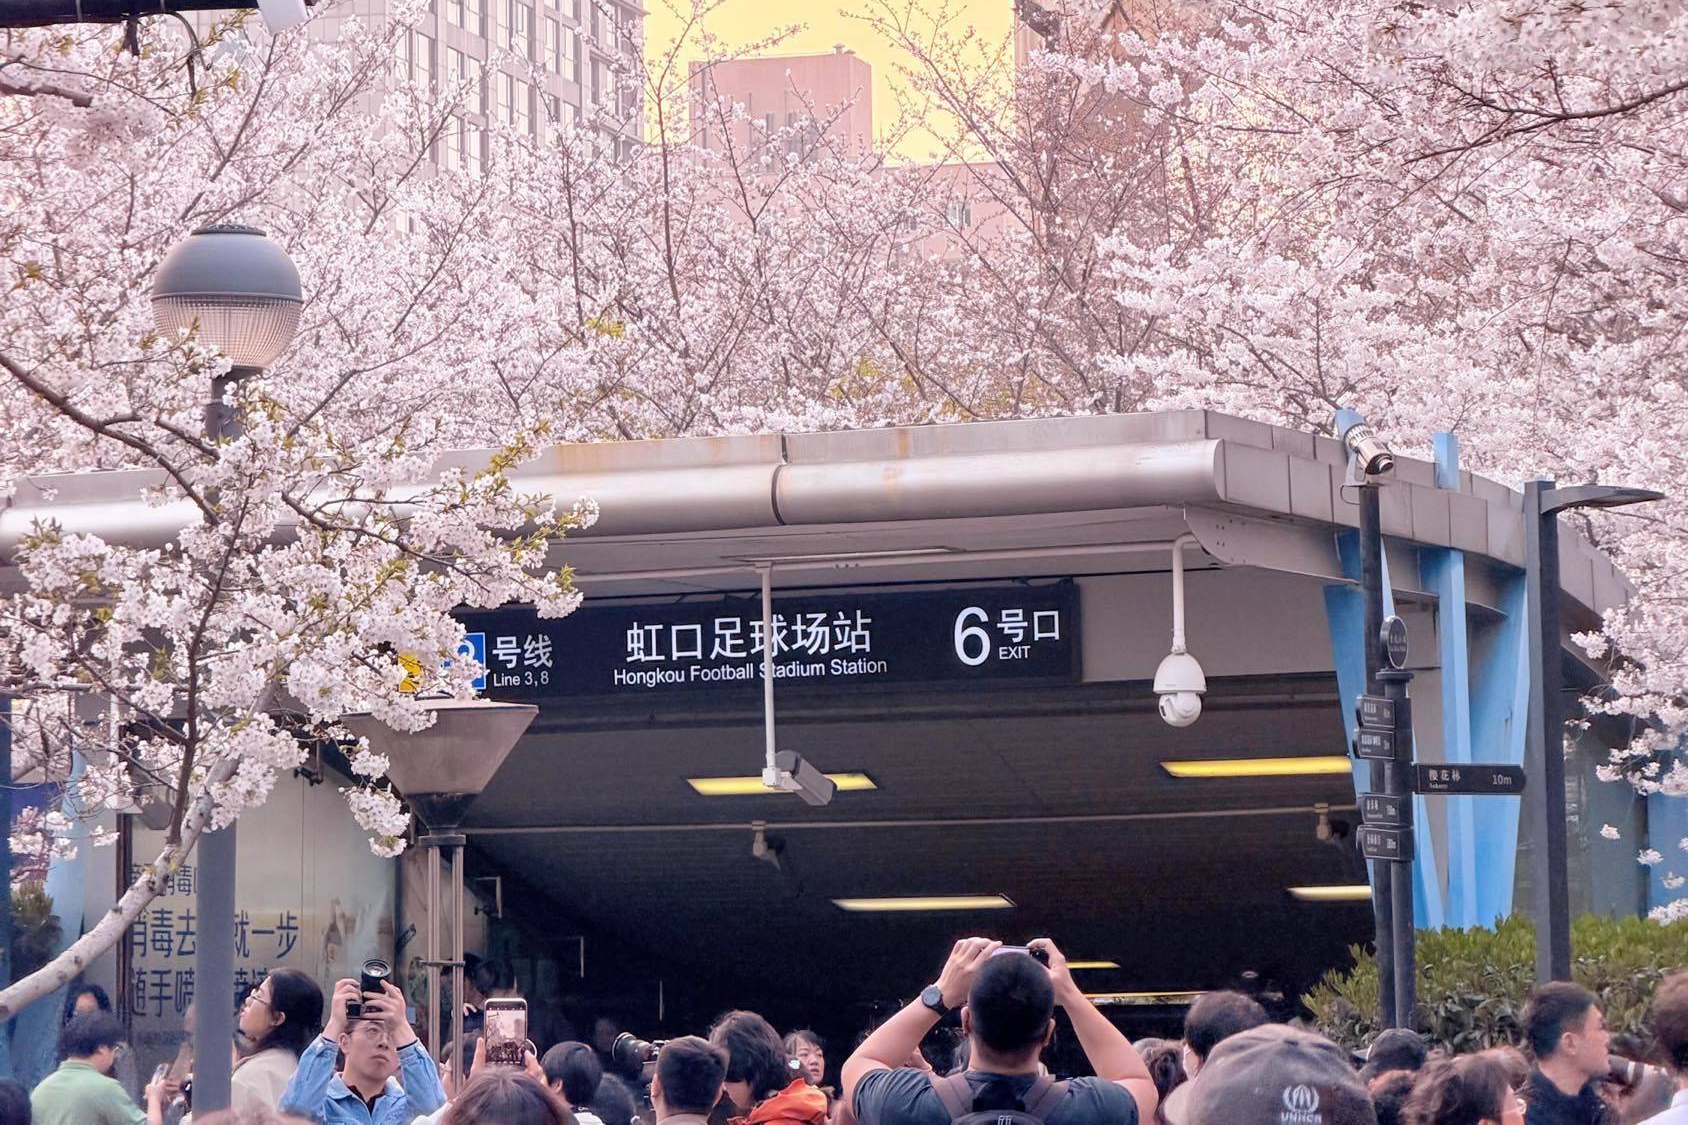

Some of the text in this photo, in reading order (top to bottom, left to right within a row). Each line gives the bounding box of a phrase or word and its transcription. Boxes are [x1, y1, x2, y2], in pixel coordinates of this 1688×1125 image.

[492, 634, 553, 669] 号线
[626, 610, 872, 662] 虹口足球场站
[954, 606, 991, 666] 6
[999, 645, 1031, 660] EXIT
[493, 673, 521, 687] Line
[613, 667, 685, 688] Hongkou
[690, 662, 754, 682] Football
[830, 657, 887, 675] Station
